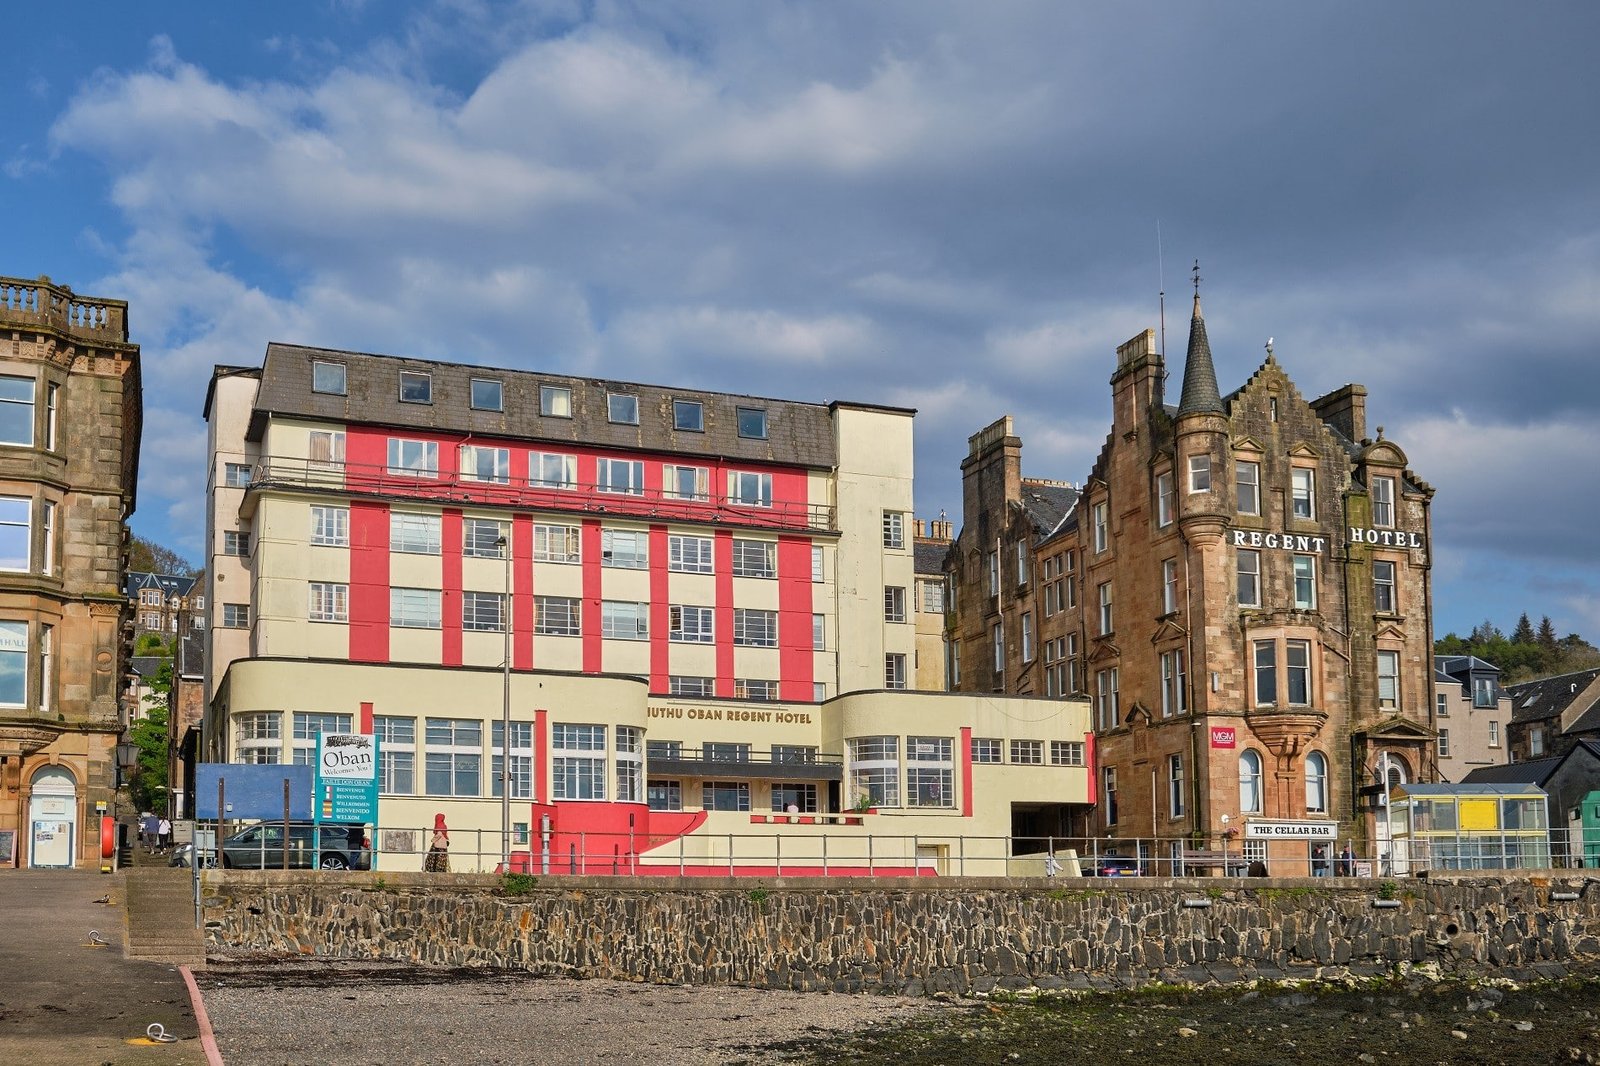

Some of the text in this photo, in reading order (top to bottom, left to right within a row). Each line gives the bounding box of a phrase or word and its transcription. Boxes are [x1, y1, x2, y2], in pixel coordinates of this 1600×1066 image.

[1233, 528, 1420, 552] REGENT HOTEL
[687, 708, 722, 721] OBAN
[726, 710, 772, 722] REGENT
[775, 712, 812, 724] HOTEL
[1212, 731, 1235, 742] MGM
[323, 751, 372, 768] Oban
[324, 767, 355, 776] Welcomes
[1253, 826, 1329, 835] THE CELLAR BAR
